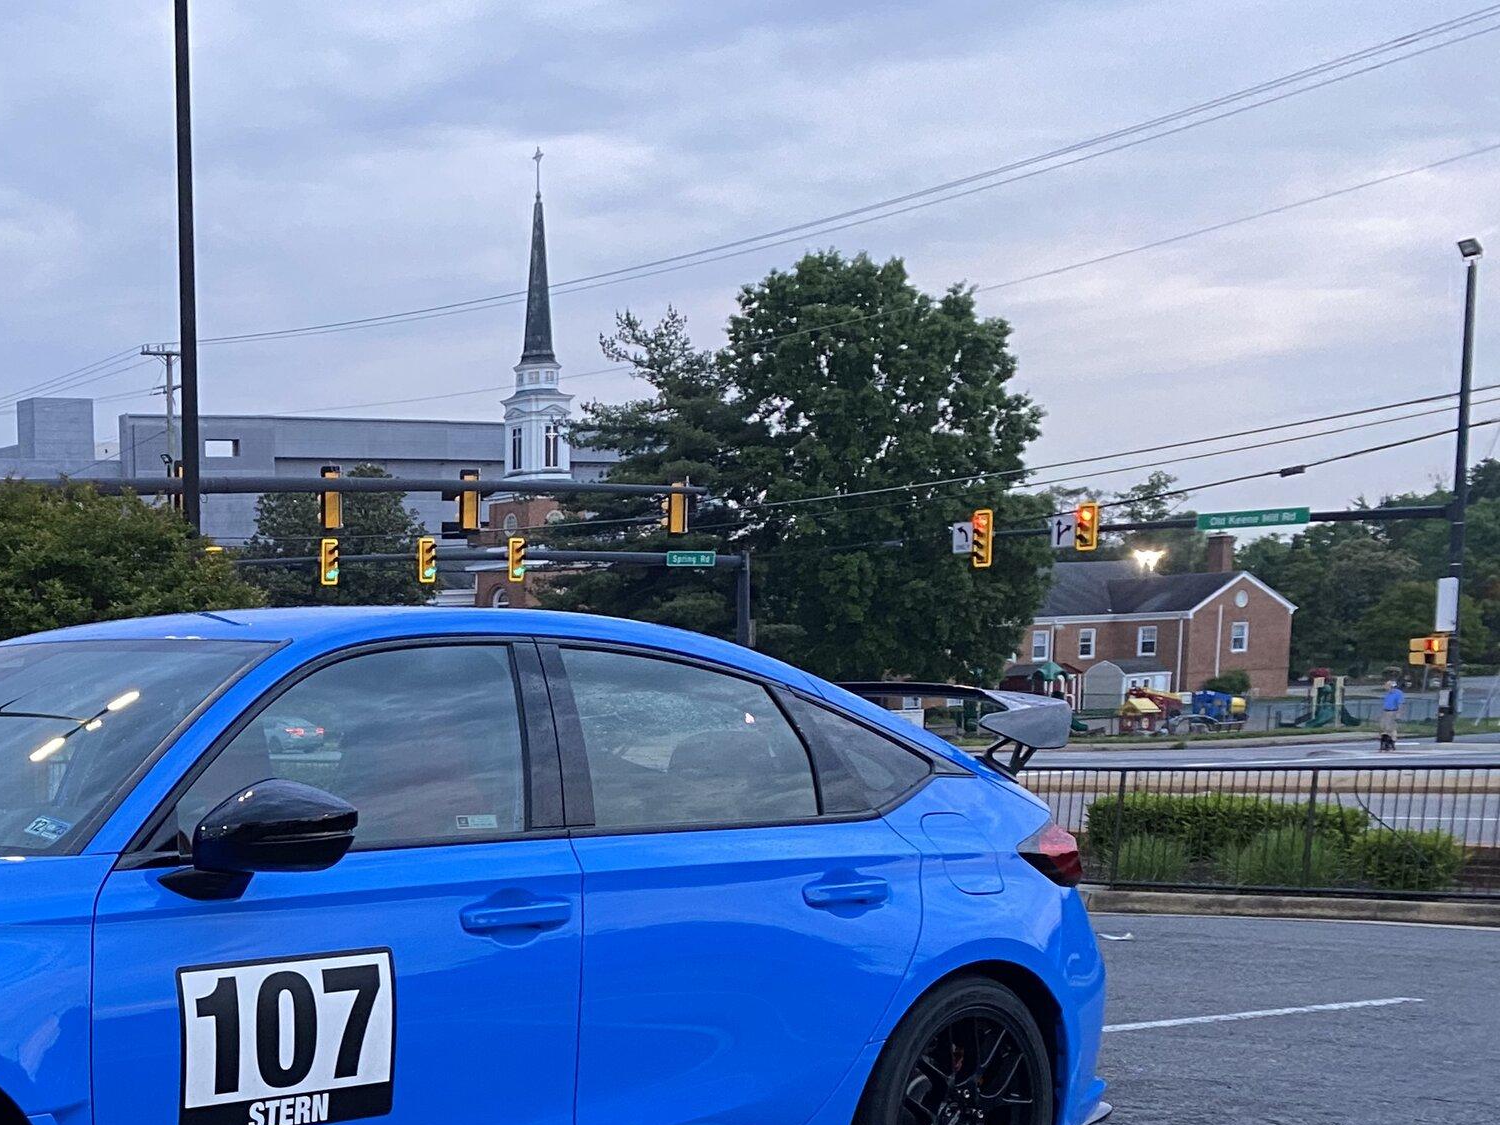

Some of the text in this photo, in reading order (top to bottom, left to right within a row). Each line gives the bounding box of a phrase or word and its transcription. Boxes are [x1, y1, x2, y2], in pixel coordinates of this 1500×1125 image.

[1209, 516, 1226, 526] Old
[1281, 512, 1297, 521] Rd
[673, 555, 710, 564] Spring Rd
[30, 820, 47, 831] 12
[195, 963, 381, 1095] 107
